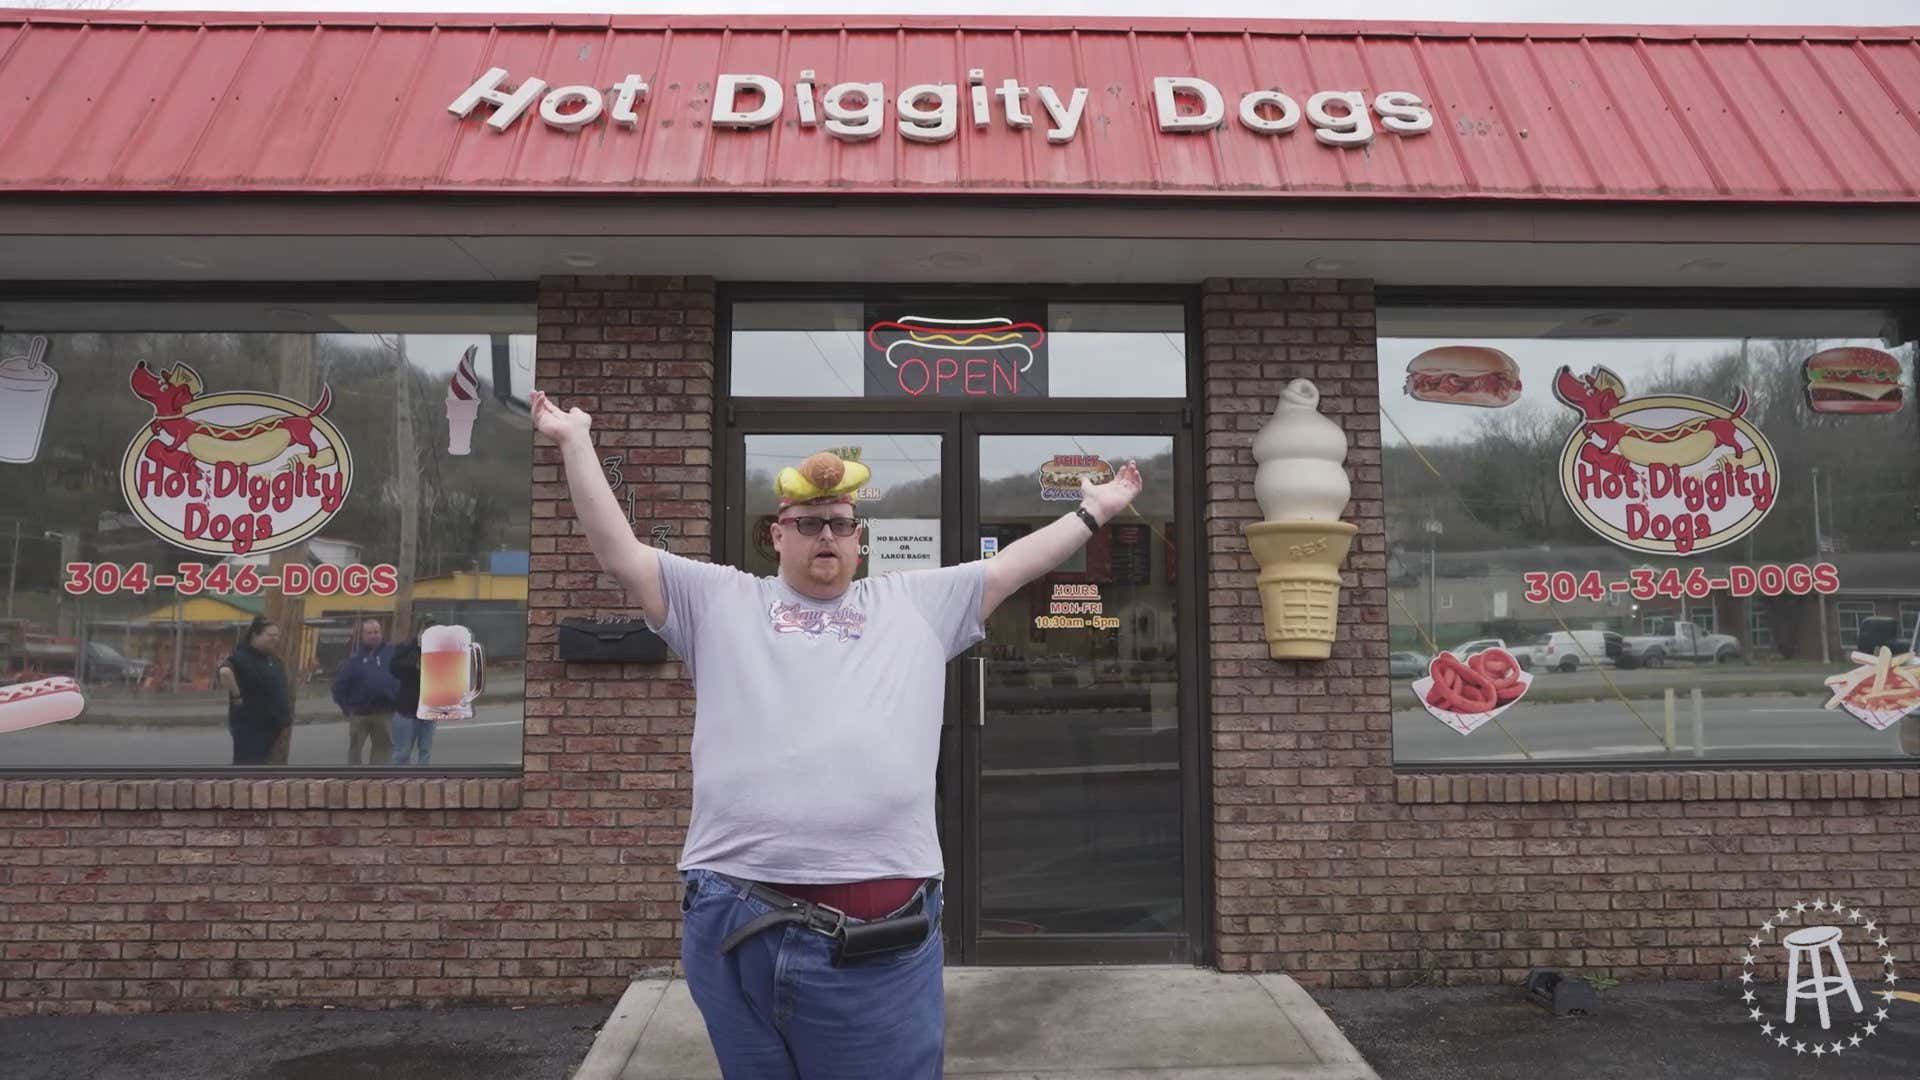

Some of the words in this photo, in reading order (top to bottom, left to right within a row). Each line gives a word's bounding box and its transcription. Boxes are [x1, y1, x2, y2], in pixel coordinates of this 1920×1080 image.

[447, 66, 651, 131] Hot
[712, 67, 1089, 143] Diggity
[1153, 76, 1434, 148] Dogs
[898, 358, 1018, 396] OPEN
[139, 460, 202, 501] Hot
[213, 461, 344, 513] Diggity
[1578, 463, 1641, 501] Hot
[1648, 462, 1773, 512] Diggity
[183, 503, 273, 554] Dogs
[1625, 503, 1711, 553] Dogs
[64, 562, 398, 595] 304-346-DOGS
[1053, 584, 1099, 597] HOURS
[1523, 562, 1840, 603] 304-346-DOGS
[1035, 615, 1084, 629] 10:30am
[1092, 615, 1120, 630] 5pm
[1050, 602, 1103, 614] MON-FRI
